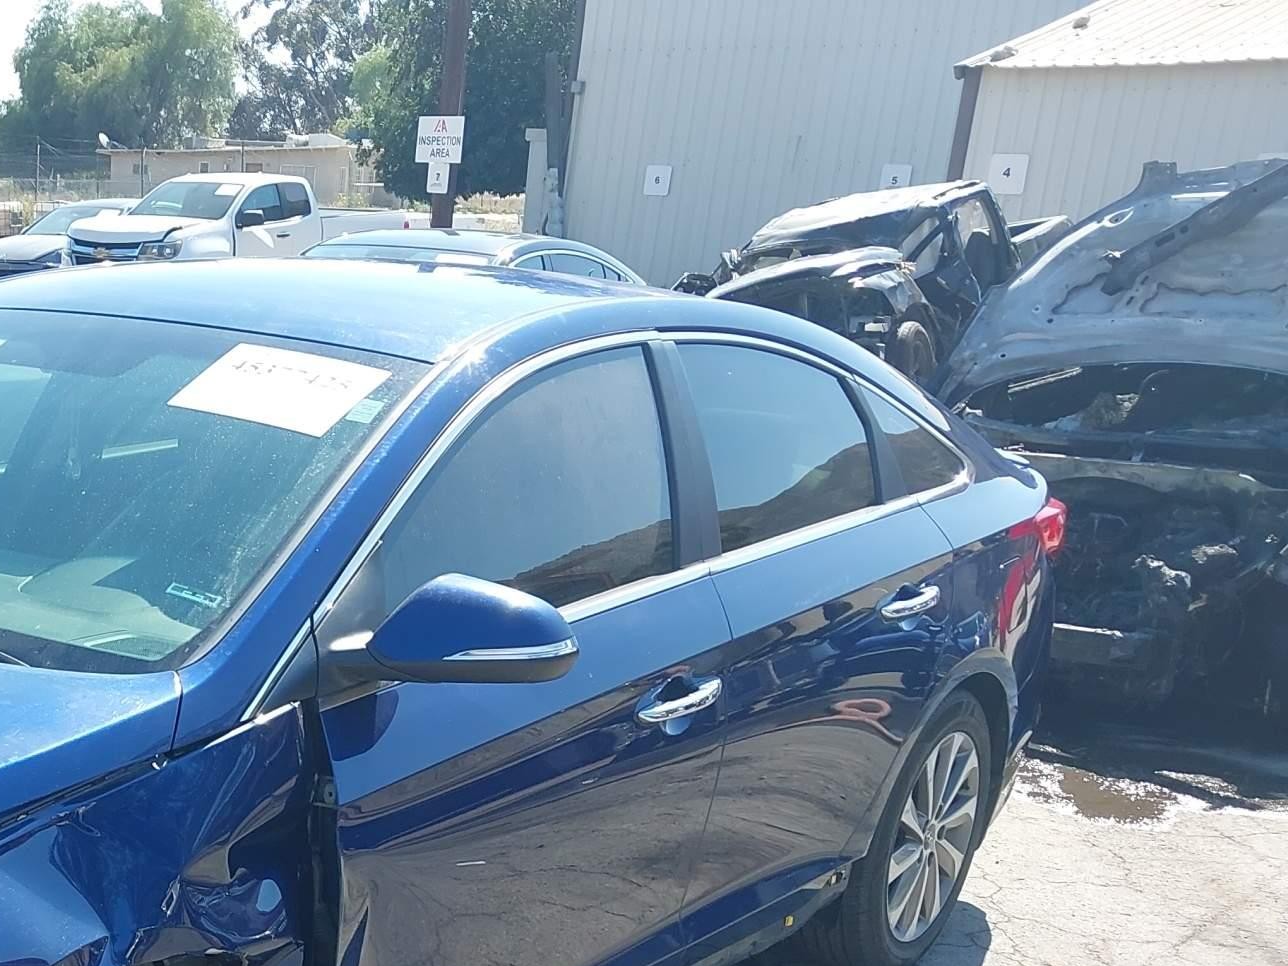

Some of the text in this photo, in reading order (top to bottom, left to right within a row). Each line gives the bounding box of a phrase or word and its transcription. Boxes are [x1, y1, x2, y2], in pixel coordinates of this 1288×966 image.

[418, 135, 461, 146] INSPECTION
[429, 148, 450, 158] AREA
[435, 172, 441, 181] 7
[1002, 167, 1011, 178] 4
[654, 175, 661, 185] 6
[891, 175, 898, 185] 5
